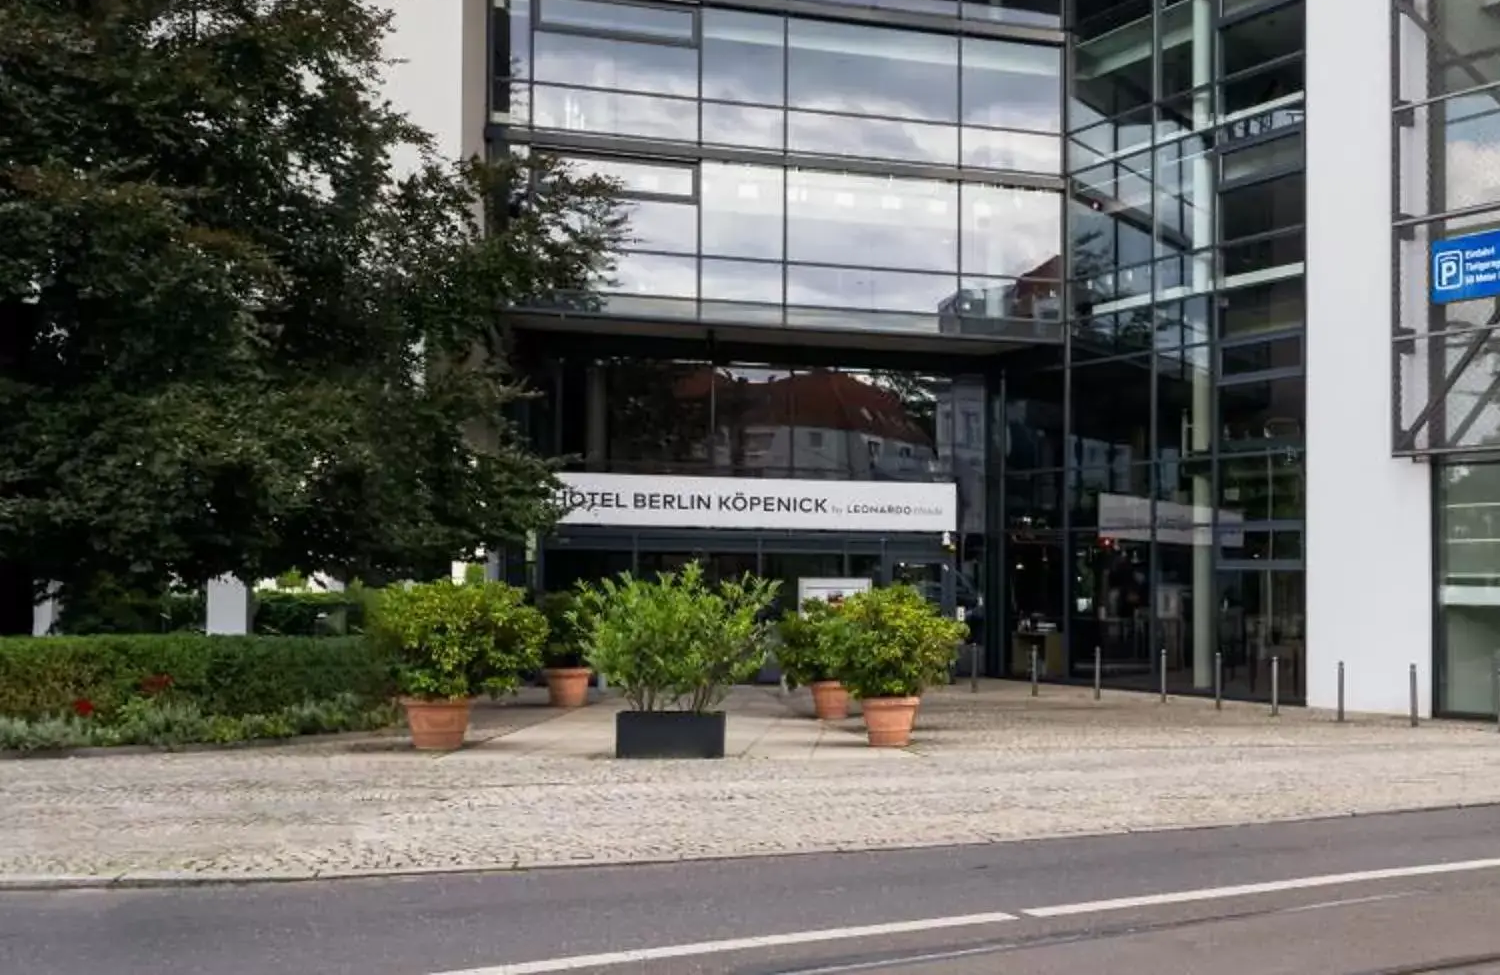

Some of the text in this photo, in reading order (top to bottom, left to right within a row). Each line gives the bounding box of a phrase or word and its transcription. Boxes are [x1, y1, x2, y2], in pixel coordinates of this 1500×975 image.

[1442, 261, 1457, 285] P
[555, 491, 627, 509] HOTEL
[633, 493, 711, 510] BERLIN
[719, 492, 828, 514] KÖPENICK
[847, 504, 911, 515] LEONARDO
